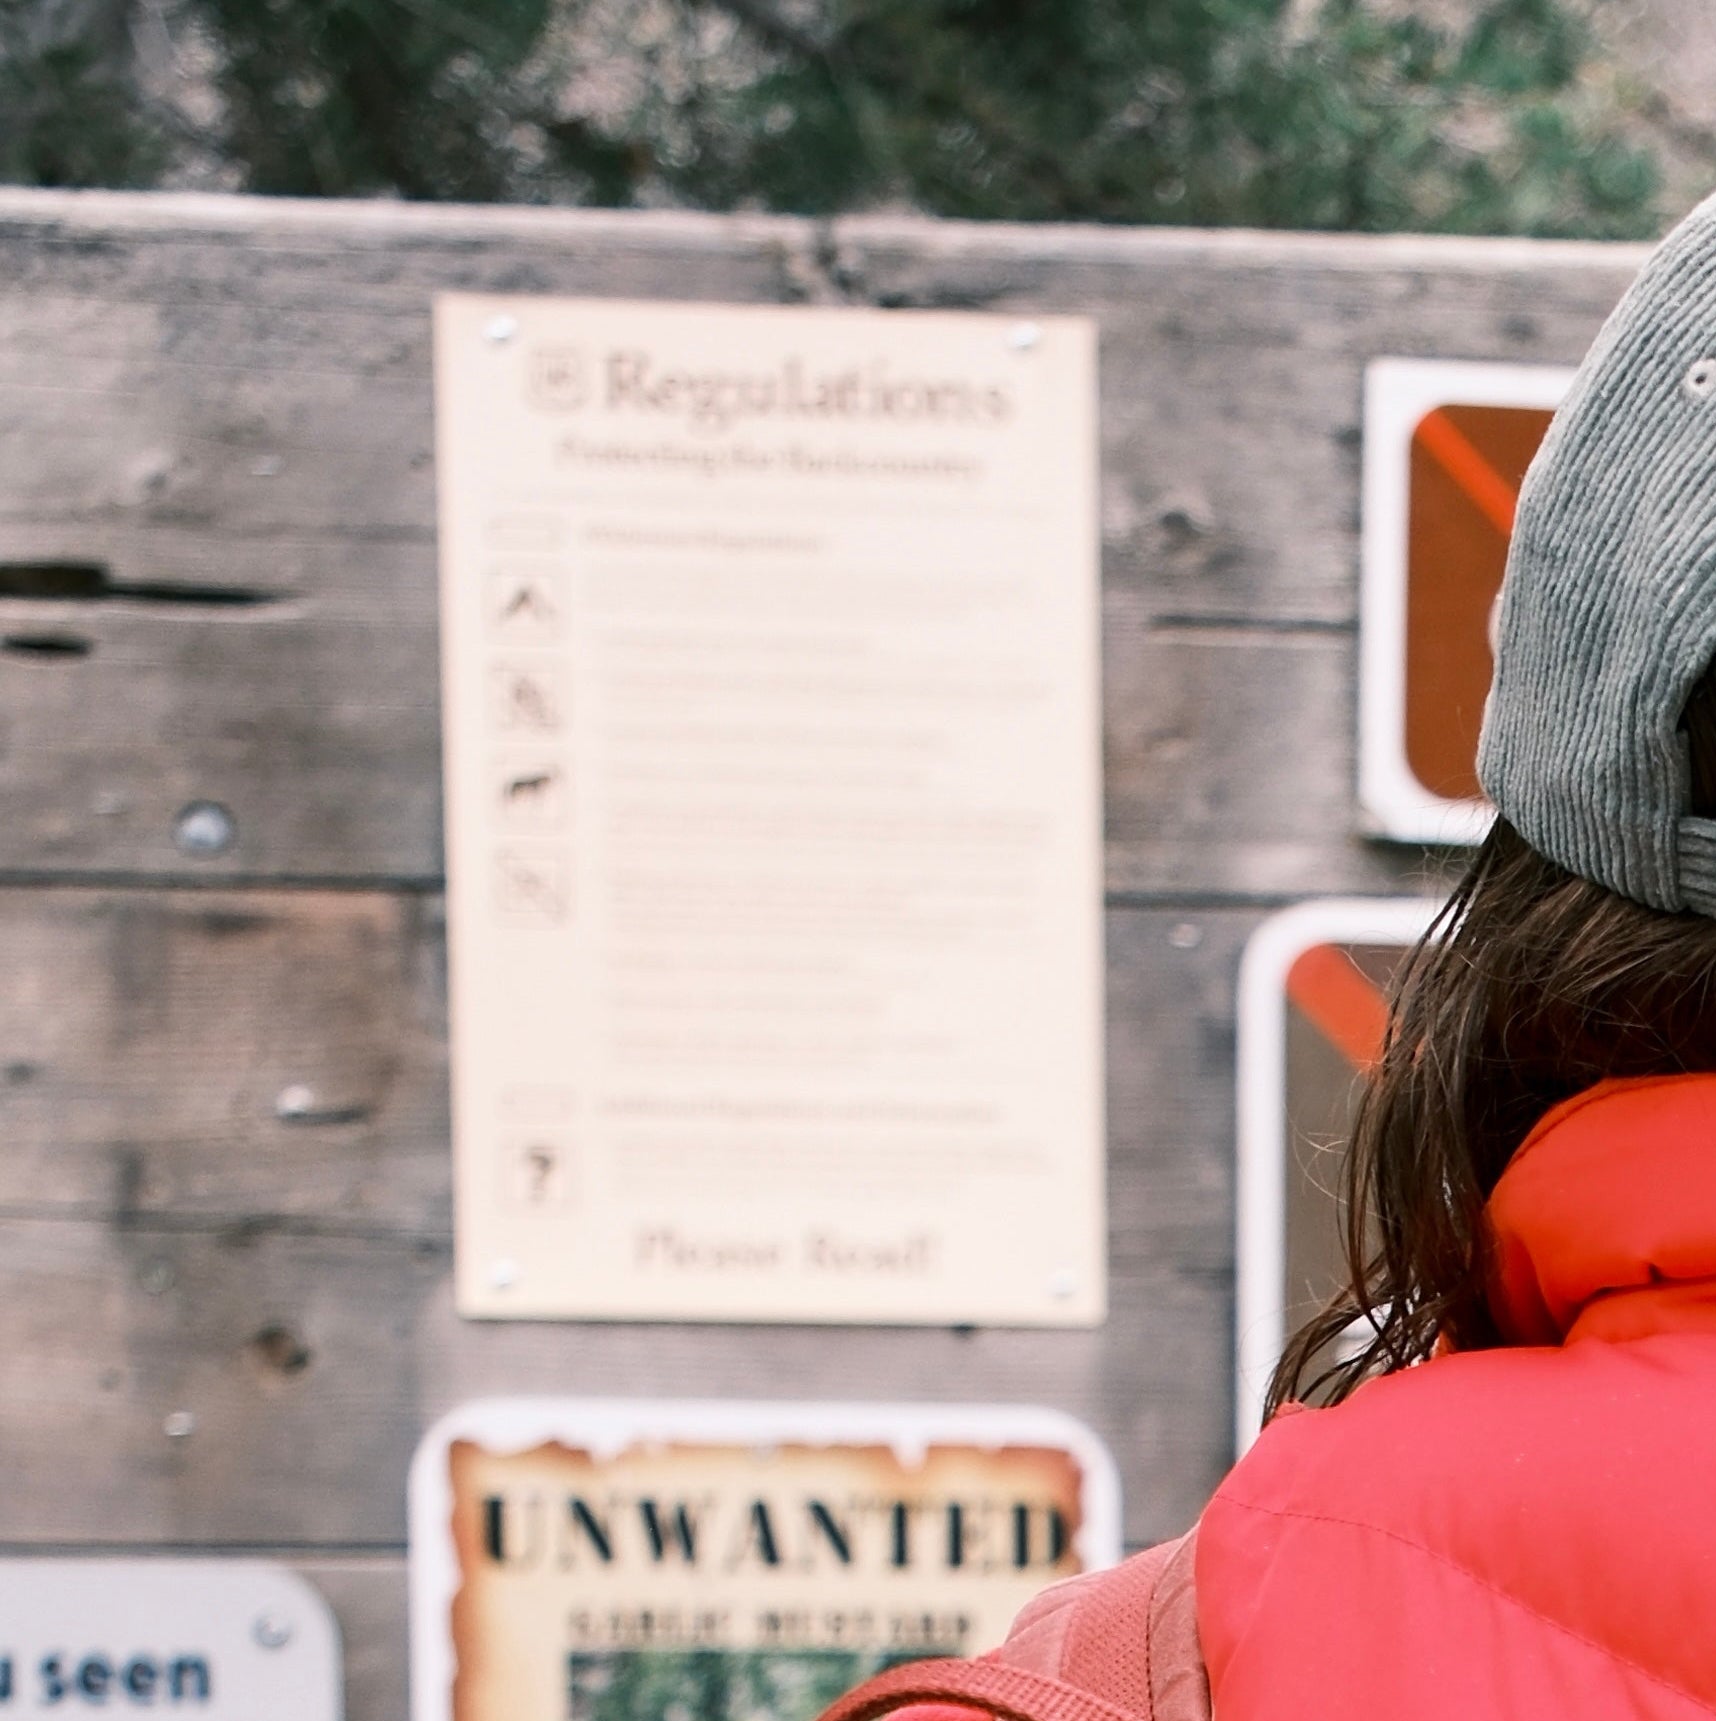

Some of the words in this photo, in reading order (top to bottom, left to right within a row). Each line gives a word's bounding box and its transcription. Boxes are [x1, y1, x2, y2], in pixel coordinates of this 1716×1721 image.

[604, 348, 1013, 434] Regulations
[480, 1494, 1072, 1572] UNWANTED
[40, 1652, 212, 1704] seen
